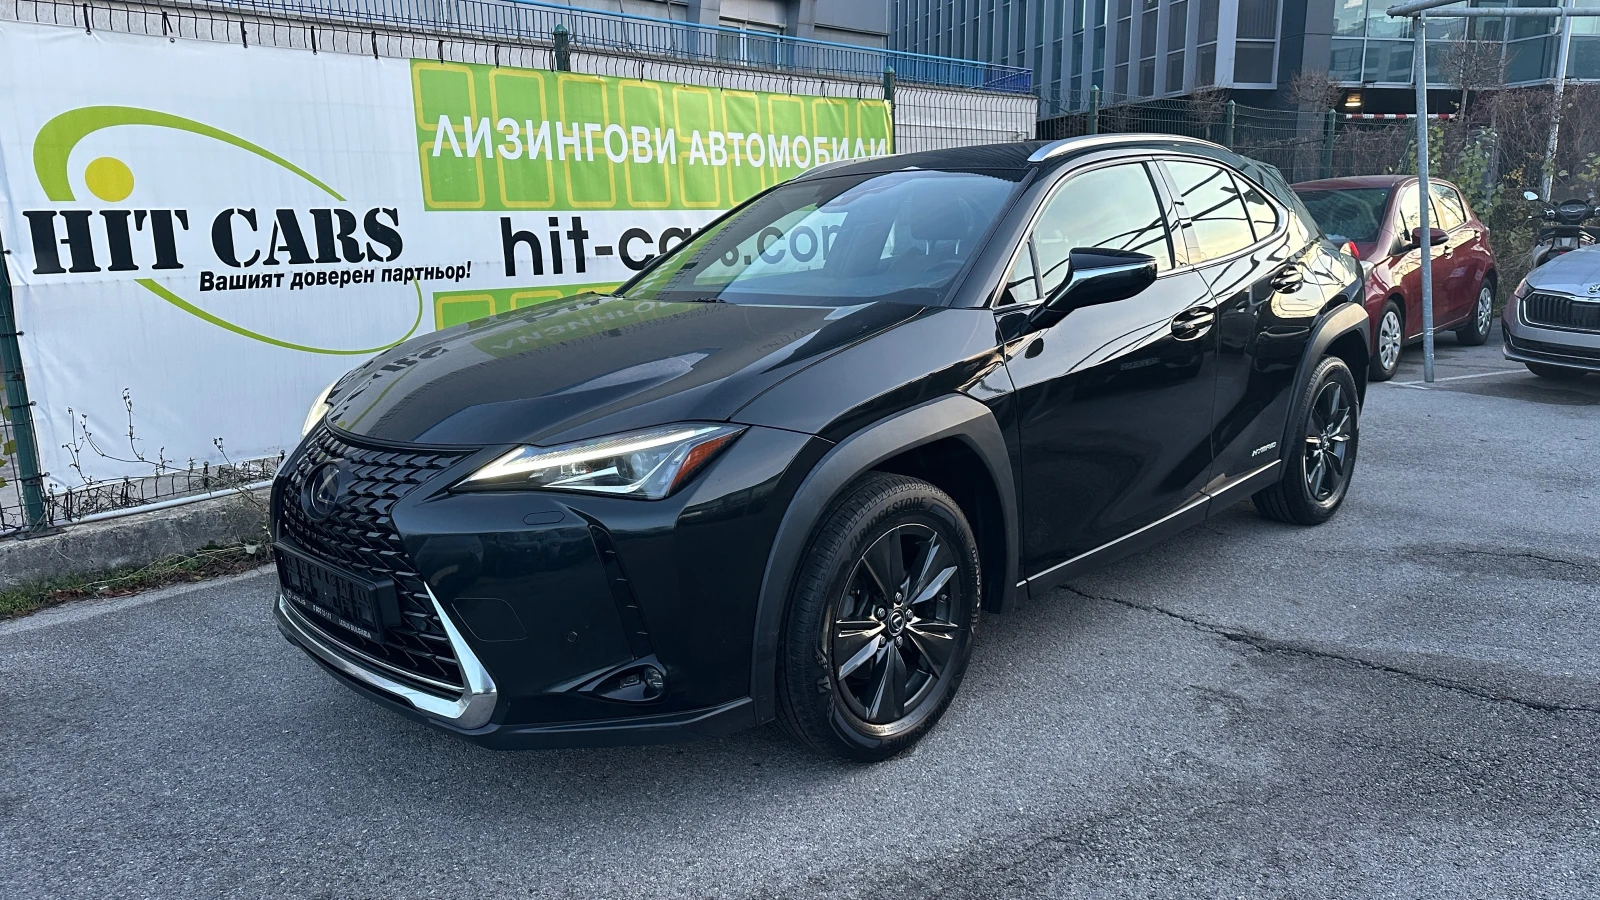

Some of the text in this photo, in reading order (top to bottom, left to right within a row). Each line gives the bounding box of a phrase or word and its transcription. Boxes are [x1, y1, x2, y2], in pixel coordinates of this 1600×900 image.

[432, 114, 677, 165] ЛИЗИНГОВИ
[22, 207, 403, 274] HIT CARS
[200, 261, 472, 292] Вашият доверен партньор!
